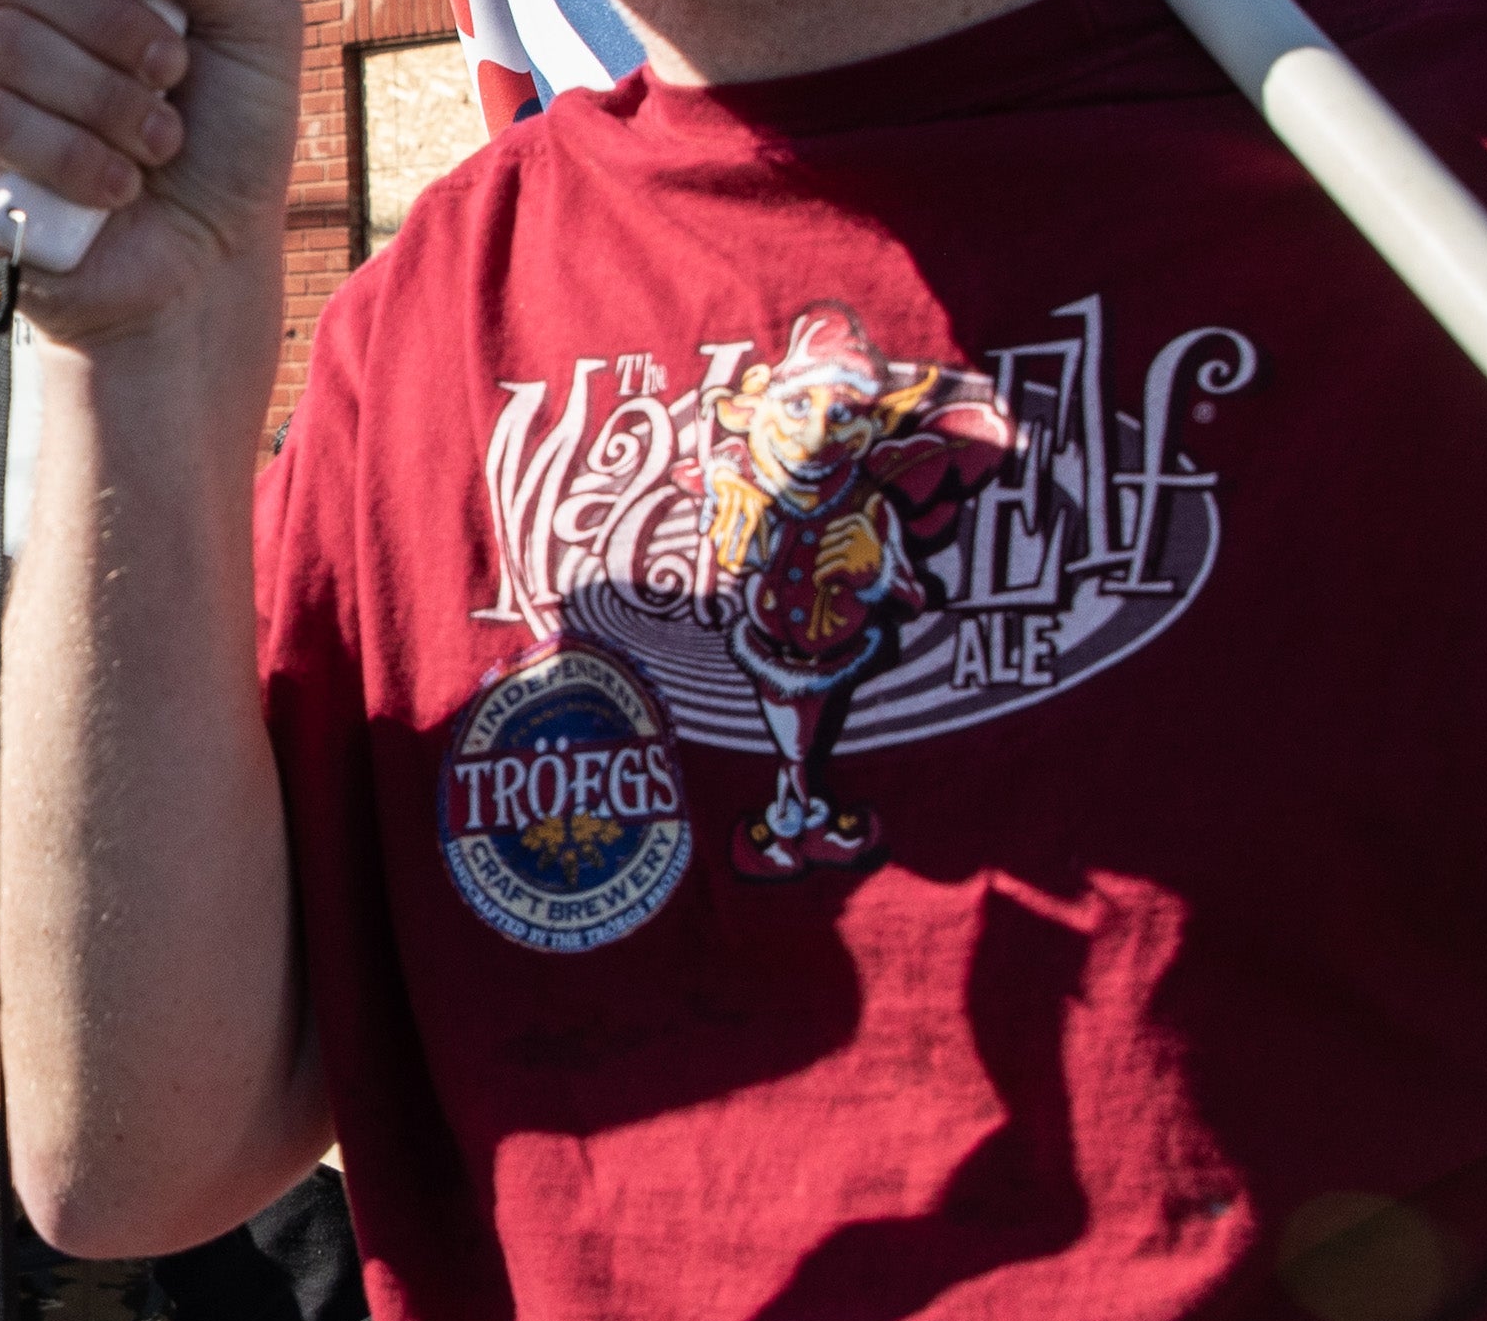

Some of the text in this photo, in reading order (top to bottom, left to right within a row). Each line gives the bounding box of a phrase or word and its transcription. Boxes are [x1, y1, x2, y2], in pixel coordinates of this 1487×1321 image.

[615, 351, 669, 397] The
[947, 293, 1259, 612] Elf
[952, 612, 1059, 688] ALE
[477, 655, 646, 743] INDEPENDENT
[454, 735, 680, 830] TRÖEGS
[469, 840, 542, 918] CRAFT
[546, 826, 674, 922] BREWERY
